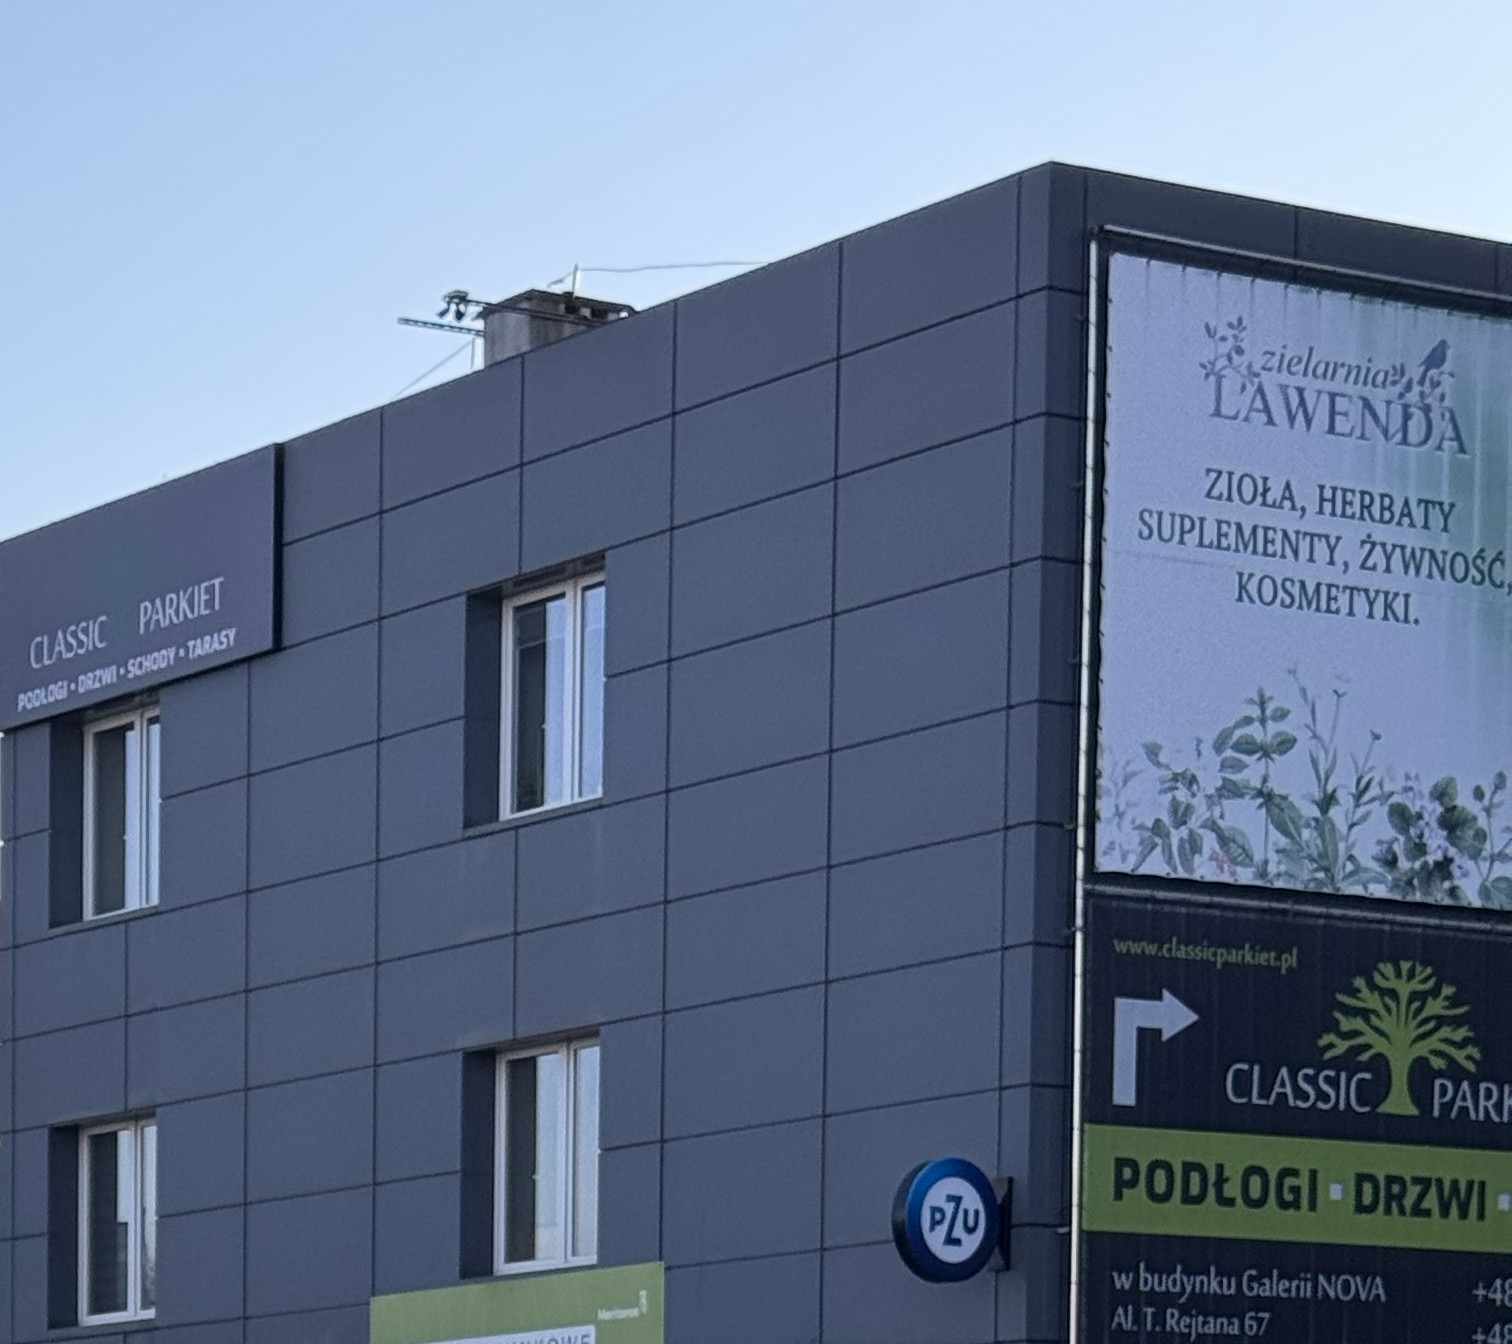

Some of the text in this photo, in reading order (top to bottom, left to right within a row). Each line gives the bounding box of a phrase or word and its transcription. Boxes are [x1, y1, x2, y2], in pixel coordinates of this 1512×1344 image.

[1260, 345, 1391, 391] zielarnia
[1209, 373, 1471, 457] LAWENDA
[1204, 467, 1456, 533] ZIOŁA, HERBATY
[1137, 508, 1350, 574] SUPLEMENTY,
[29, 576, 225, 669] CLASSIC PARKIET
[1234, 571, 1421, 627] KOSMETYKI.
[77, 664, 117, 694] DRZWI
[126, 647, 176, 679] SCHODY
[186, 627, 238, 660] TARASY
[1113, 936, 1298, 975] www.classicparkiet.pl
[1225, 1063, 1373, 1113] CLASSIC
[1112, 1156, 1487, 1222] PODŁOGI DRZWI
[928, 1194, 980, 1247] PZU
[1112, 1271, 1133, 1290] w
[1139, 1262, 1236, 1304] budynku
[1242, 1268, 1312, 1299] Galerii
[1317, 1274, 1386, 1303] NOVA
[1143, 1308, 1161, 1333] T.
[1165, 1308, 1240, 1342] Rejtana
[1244, 1311, 1271, 1336] 67
